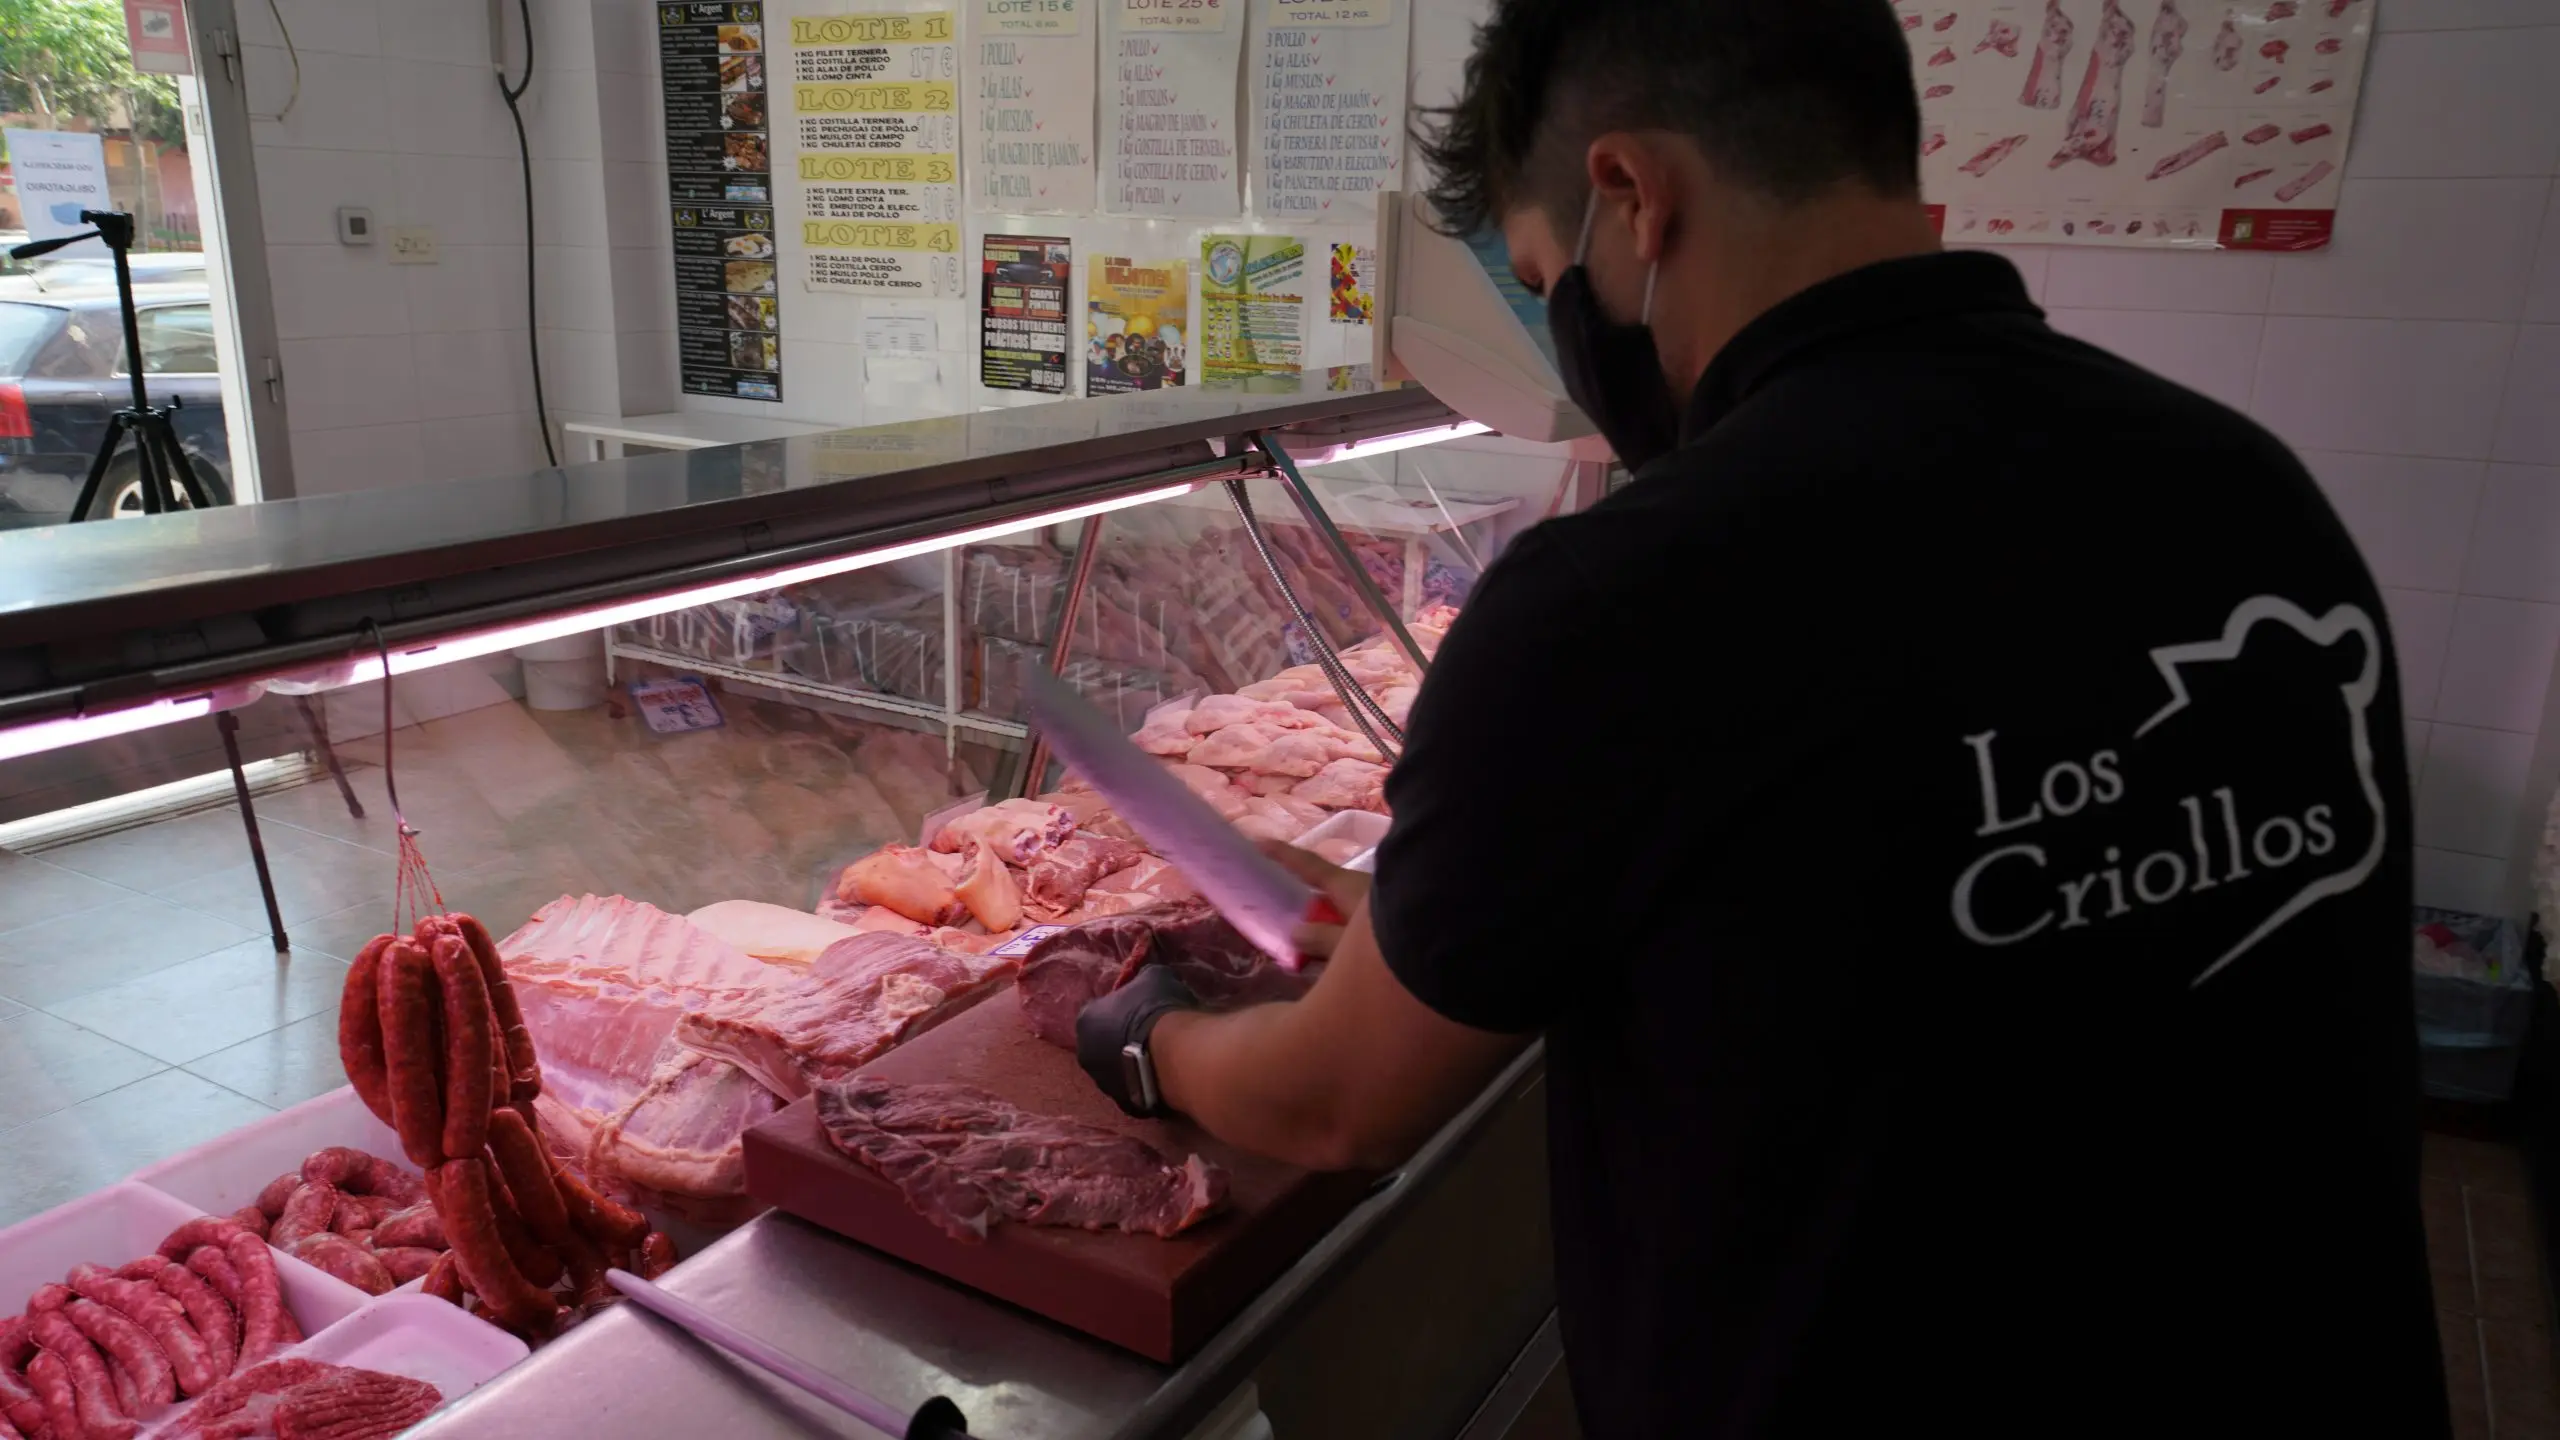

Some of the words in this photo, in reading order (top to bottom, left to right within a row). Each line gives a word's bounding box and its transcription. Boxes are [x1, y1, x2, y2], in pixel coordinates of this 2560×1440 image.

[698, 4, 723, 15] Argent
[987, 0, 1033, 14] LOTE
[1039, 0, 1059, 13] 15
[1062, 0, 1074, 12] €
[1128, 0, 1173, 9] LOTE
[1178, 0, 1203, 9] 25
[1207, 0, 1220, 9] €
[1139, 16, 1172, 25] TOTAL
[1289, 11, 1331, 21] TOTAL
[1335, 10, 1350, 19] 12
[794, 17, 912, 43] LOTE
[925, 17, 948, 39] 1
[1000, 20, 1033, 29] TOTAL
[1274, 32, 1306, 47] POLLO
[801, 50, 814, 58] KG
[816, 49, 844, 57] FILETE
[847, 48, 888, 56] TERNERA
[801, 58, 815, 66] KG
[816, 57, 857, 65] COSTILLA
[859, 56, 891, 64] CERDO
[1286, 53, 1311, 68] ALAS
[854, 64, 885, 72] POLLO
[1284, 73, 1324, 89] MUSLOS
[798, 87, 912, 111] LOTE
[924, 89, 950, 111] 2
[1283, 94, 1320, 109] MAGRO
[1322, 94, 1336, 109] DE
[1337, 88, 1370, 113] JAMÓN
[862, 117, 904, 125] TERNERA
[1283, 115, 1329, 129] CHULETA
[1330, 115, 1344, 129] DE
[1346, 114, 1378, 129] CERDO
[822, 125, 869, 133] PECHUGAS
[806, 133, 818, 141] KG
[819, 133, 853, 141] MUSLOS
[1283, 135, 1327, 150] TERNERA
[1329, 135, 1343, 150] DE
[1345, 135, 1379, 150] GUISAR
[1032, 143, 1045, 165] DE
[1135, 139, 1175, 156] COSTILLA
[1176, 139, 1188, 156] DE
[1283, 155, 1334, 170] EMBUTIDO
[1335, 156, 1343, 170] A
[1345, 152, 1389, 171] ELECCIÓN
[800, 157, 916, 180] LOTE
[926, 161, 952, 183] 3
[1134, 163, 1173, 180] COSTILLA
[1175, 163, 1188, 181] DE
[1189, 164, 1218, 181] CERDO
[1284, 176, 1325, 190] PANCETA
[1327, 176, 1340, 190] DE
[1342, 176, 1374, 191] CERDO
[828, 195, 854, 203] LOMO
[1135, 187, 1165, 204] PICADA
[1284, 195, 1317, 210] PICADA
[867, 211, 900, 219] POLLO
[804, 222, 917, 248] LOTE
[927, 229, 953, 253] 4
[864, 256, 895, 264] POLLO
[829, 263, 867, 271] COSTILLA
[869, 264, 902, 272] CERDO
[830, 270, 858, 278] MUSLO
[860, 271, 889, 279] POLLO
[829, 278, 871, 286] CHULETAS
[887, 280, 922, 288] CERDO
[985, 317, 1018, 330] CURSOS
[1962, 729, 2125, 836] Los
[1951, 786, 2336, 945] Criollos
